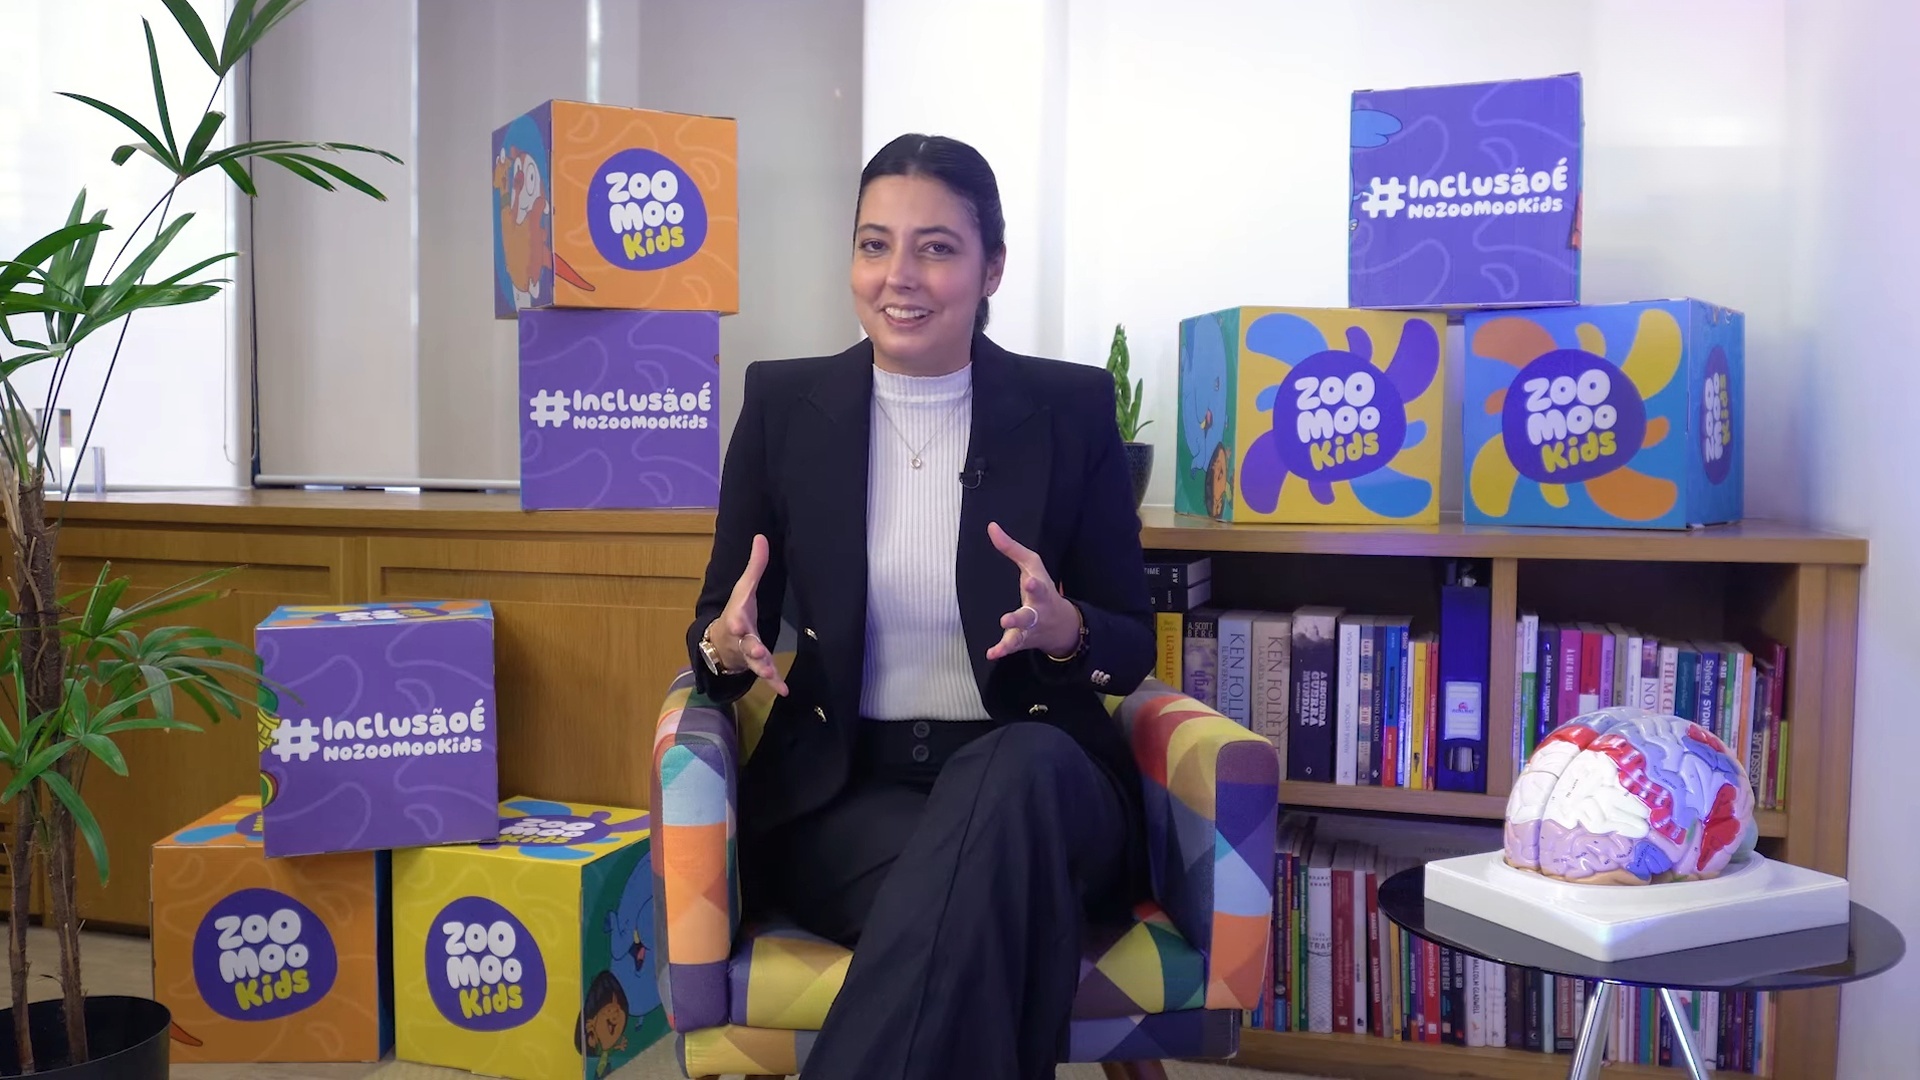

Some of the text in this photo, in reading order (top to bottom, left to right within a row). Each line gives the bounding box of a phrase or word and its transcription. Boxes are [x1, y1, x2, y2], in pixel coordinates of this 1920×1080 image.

[605, 169, 679, 203] ZOO
[609, 200, 685, 234] MOO
[622, 225, 685, 261] Kids
[1294, 371, 1375, 410] ZOO
[1523, 368, 1611, 412] ZOO
[1296, 405, 1381, 444] MOO
[1527, 404, 1617, 445] MOO
[1309, 432, 1380, 471] Kids
[1541, 431, 1617, 473] Kids
[1194, 622, 1214, 630] SCOTT
[1230, 633, 1245, 669] KEN
[1268, 636, 1283, 672] KEN
[1221, 655, 1229, 691] INVIERNO
[1565, 674, 1574, 691] PARIS
[1663, 662, 1675, 694] FILM
[1702, 660, 1714, 696] StyleCity
[1301, 670, 1311, 726] MUNDIAL
[1309, 671, 1320, 726] GUERRA
[1318, 671, 1328, 727] A SEGUNDA
[1751, 732, 1762, 787] NOSSO LAR
[214, 908, 301, 950] ZOO
[442, 920, 516, 957] ZOO
[219, 943, 309, 983] MOO
[446, 955, 522, 989] MOO
[1428, 943, 1436, 998] xperiência Apple
[234, 969, 310, 1011] Kids
[459, 983, 523, 1019] Kids
